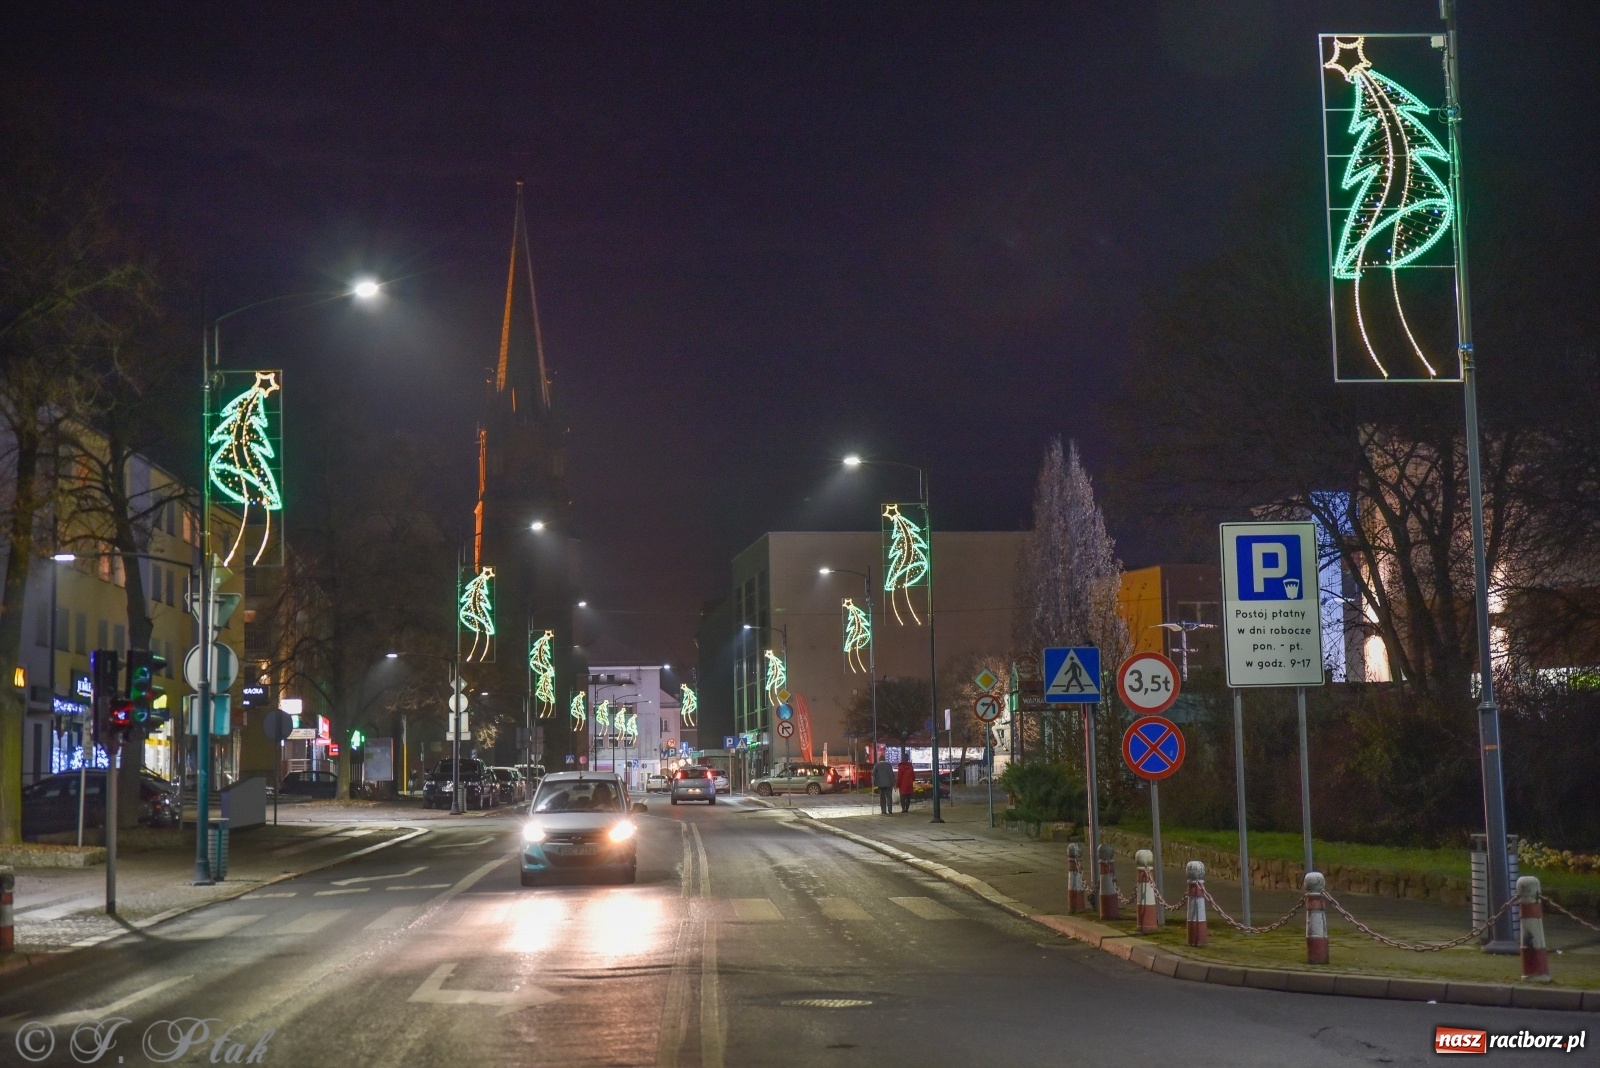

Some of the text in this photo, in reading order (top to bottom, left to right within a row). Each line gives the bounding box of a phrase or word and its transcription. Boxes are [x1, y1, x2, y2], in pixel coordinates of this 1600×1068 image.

[1251, 542, 1288, 593] P
[1235, 609, 1306, 620] Postój płatny
[1249, 626, 1266, 635] dni
[1270, 626, 1312, 635] robocze
[1252, 643, 1276, 652] pon.
[1289, 642, 1304, 653] pt.
[1245, 659, 1311, 670] w godz. 9-17
[1128, 669, 1171, 696] 3,5t
[726, 737, 734, 748] P
